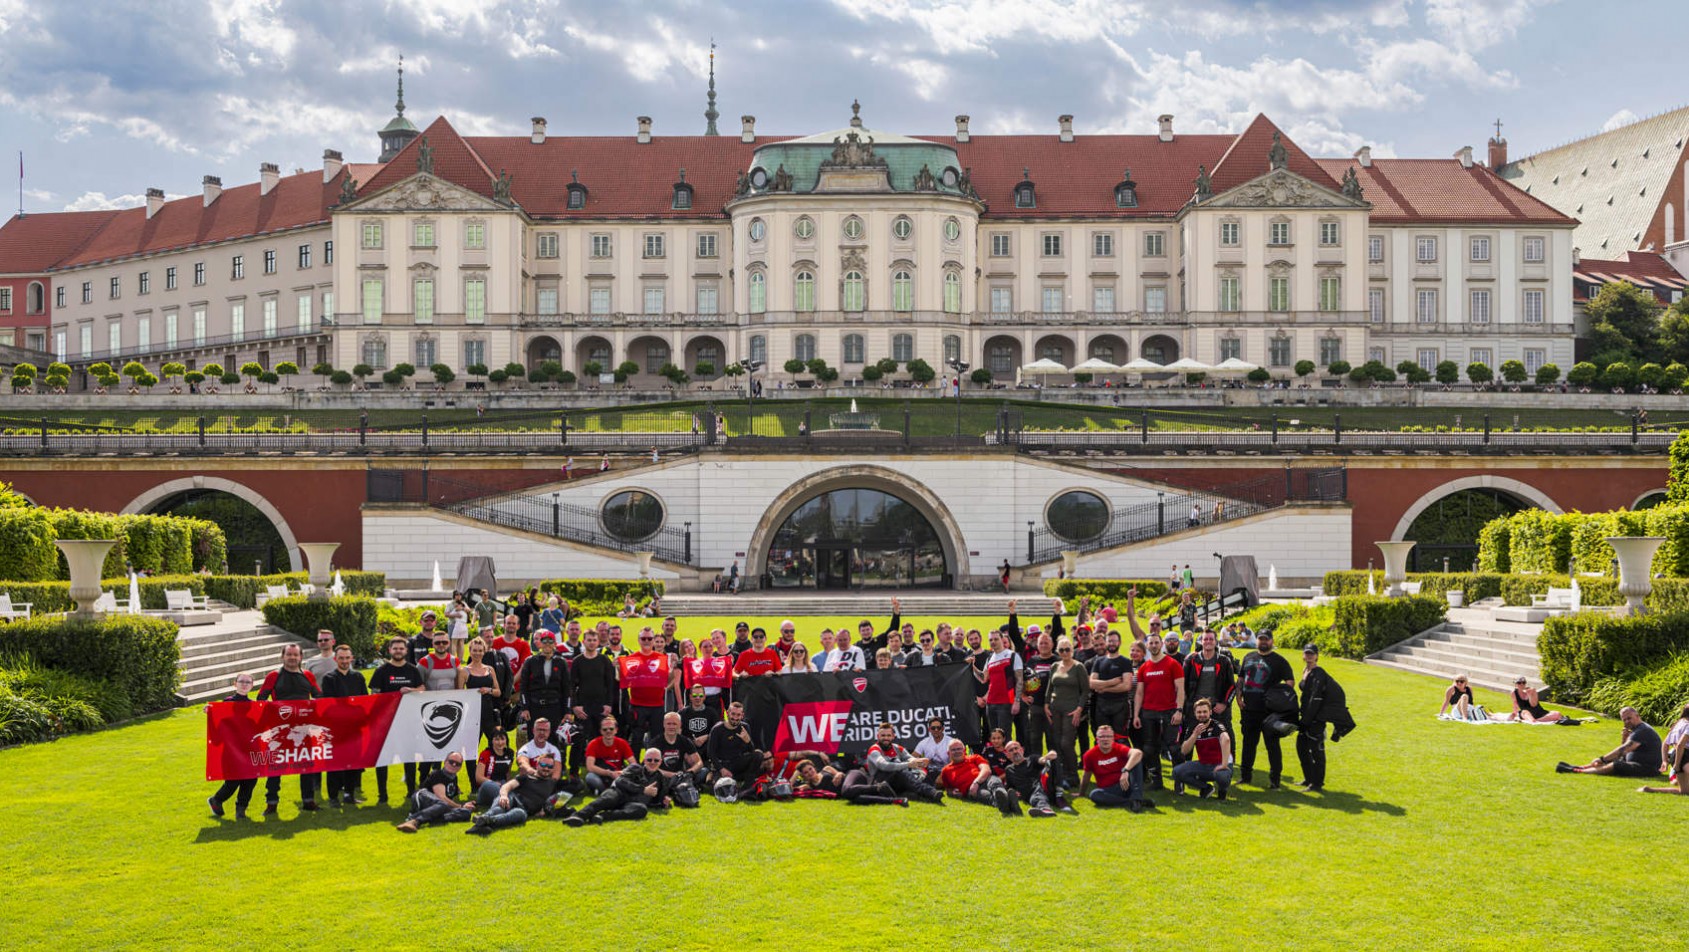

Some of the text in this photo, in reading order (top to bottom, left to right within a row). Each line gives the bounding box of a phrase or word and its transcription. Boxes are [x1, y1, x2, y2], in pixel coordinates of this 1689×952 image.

[788, 706, 956, 743] WE ARE DUCATI.
[914, 721, 956, 738] OE.
